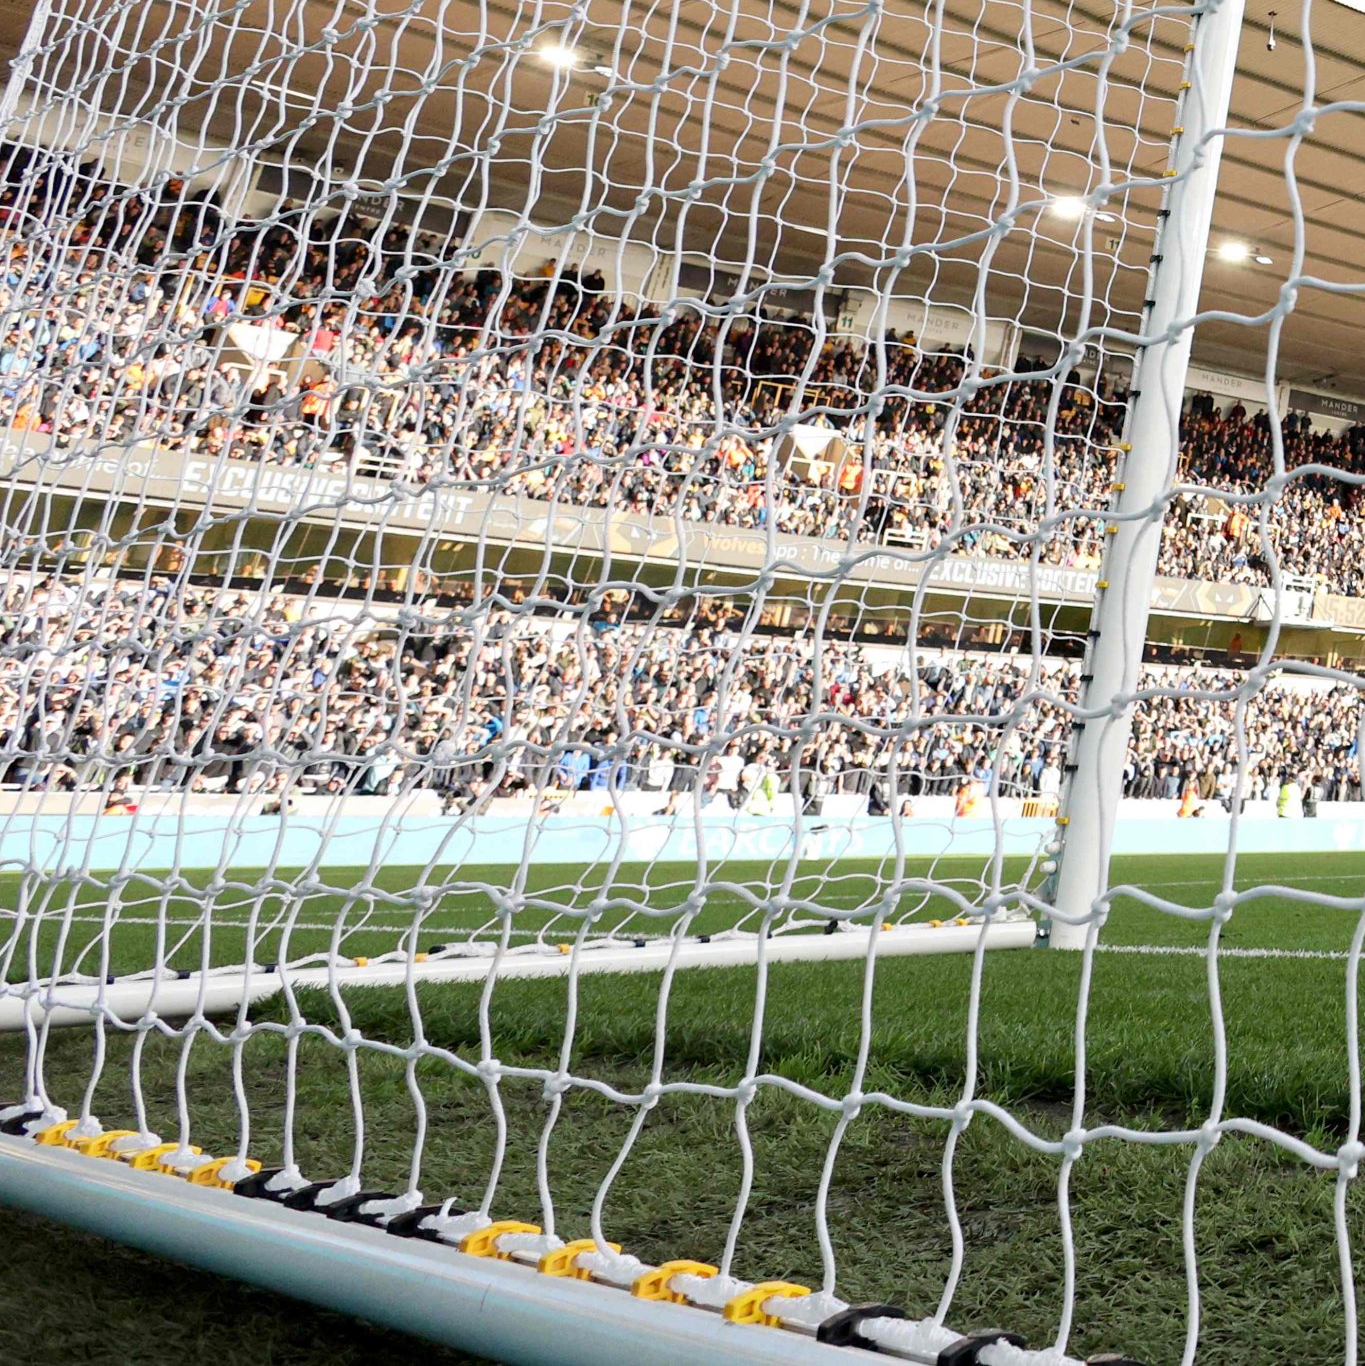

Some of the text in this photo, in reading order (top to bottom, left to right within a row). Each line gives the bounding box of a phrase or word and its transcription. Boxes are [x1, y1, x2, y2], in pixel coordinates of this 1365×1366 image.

[841, 316, 853, 328] 11
[1201, 374, 1243, 388] MANDER
[1320, 399, 1359, 414] MANDER
[929, 559, 1030, 590] EXCLUSIVE
